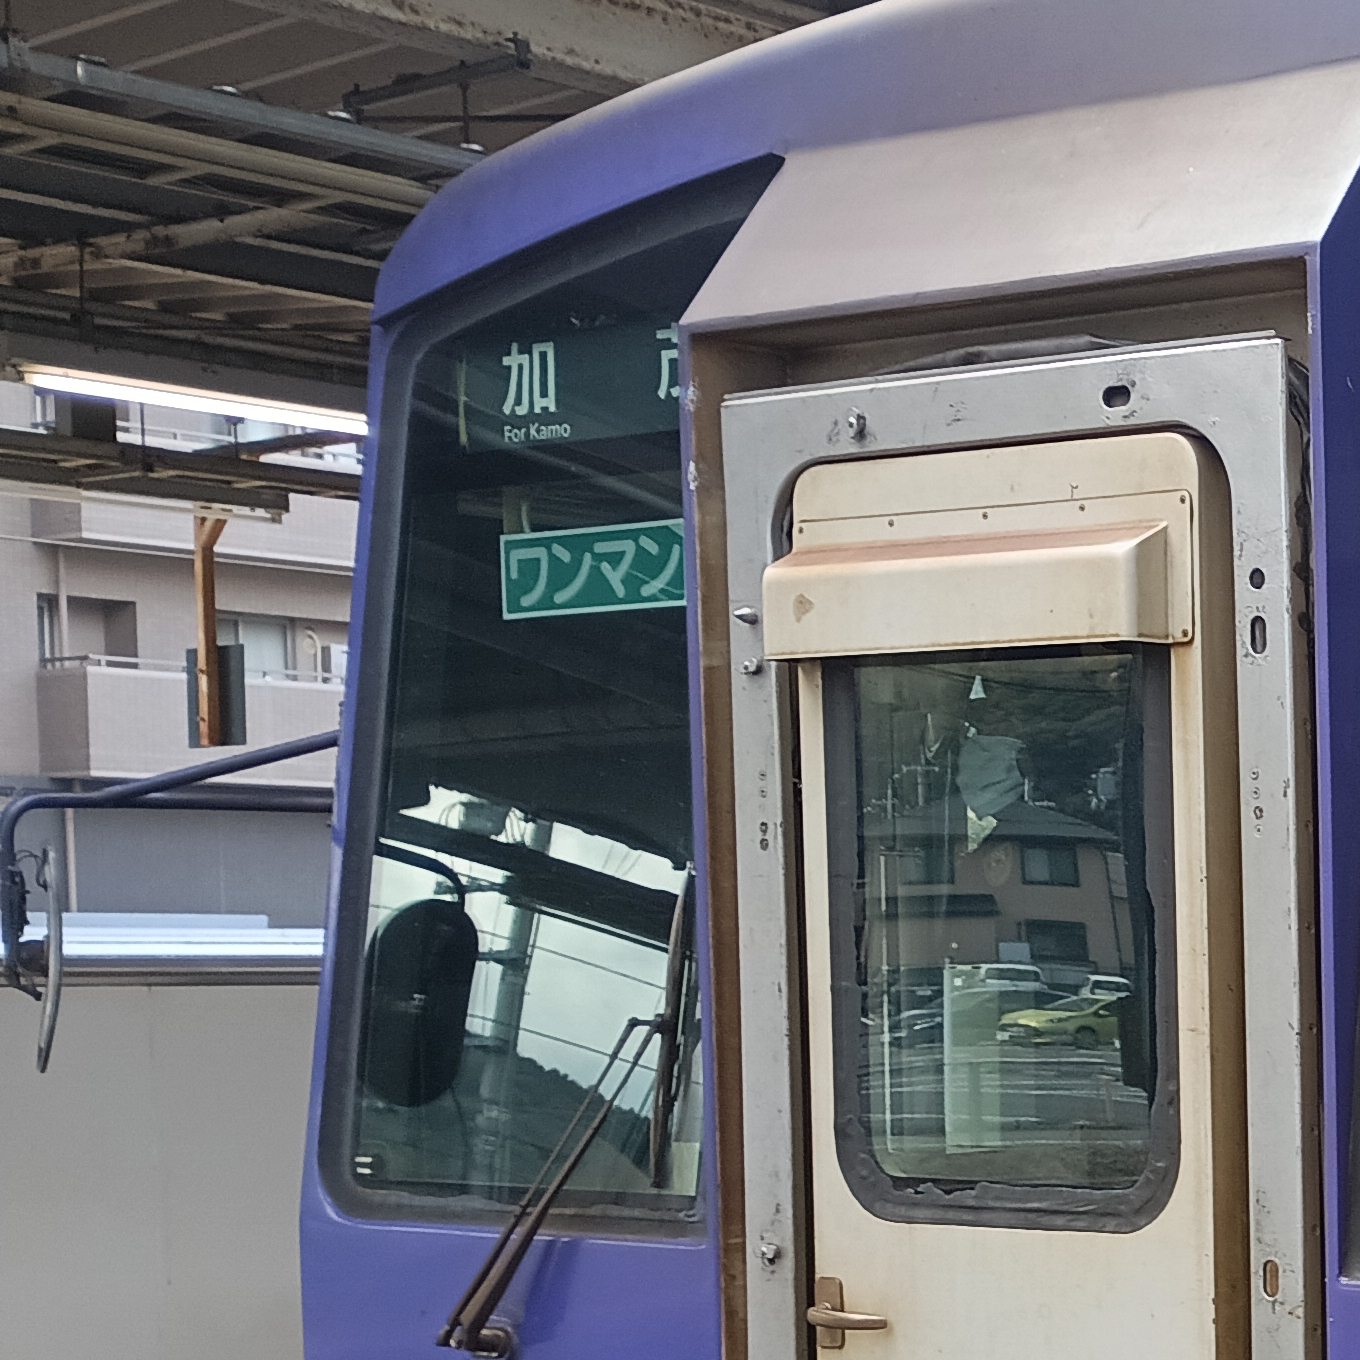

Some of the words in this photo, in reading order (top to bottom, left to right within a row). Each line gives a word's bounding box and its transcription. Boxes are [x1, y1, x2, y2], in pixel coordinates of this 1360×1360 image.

[504, 425, 527, 443] For
[529, 422, 571, 440] Kamo
[509, 535, 680, 607] ワンマン
